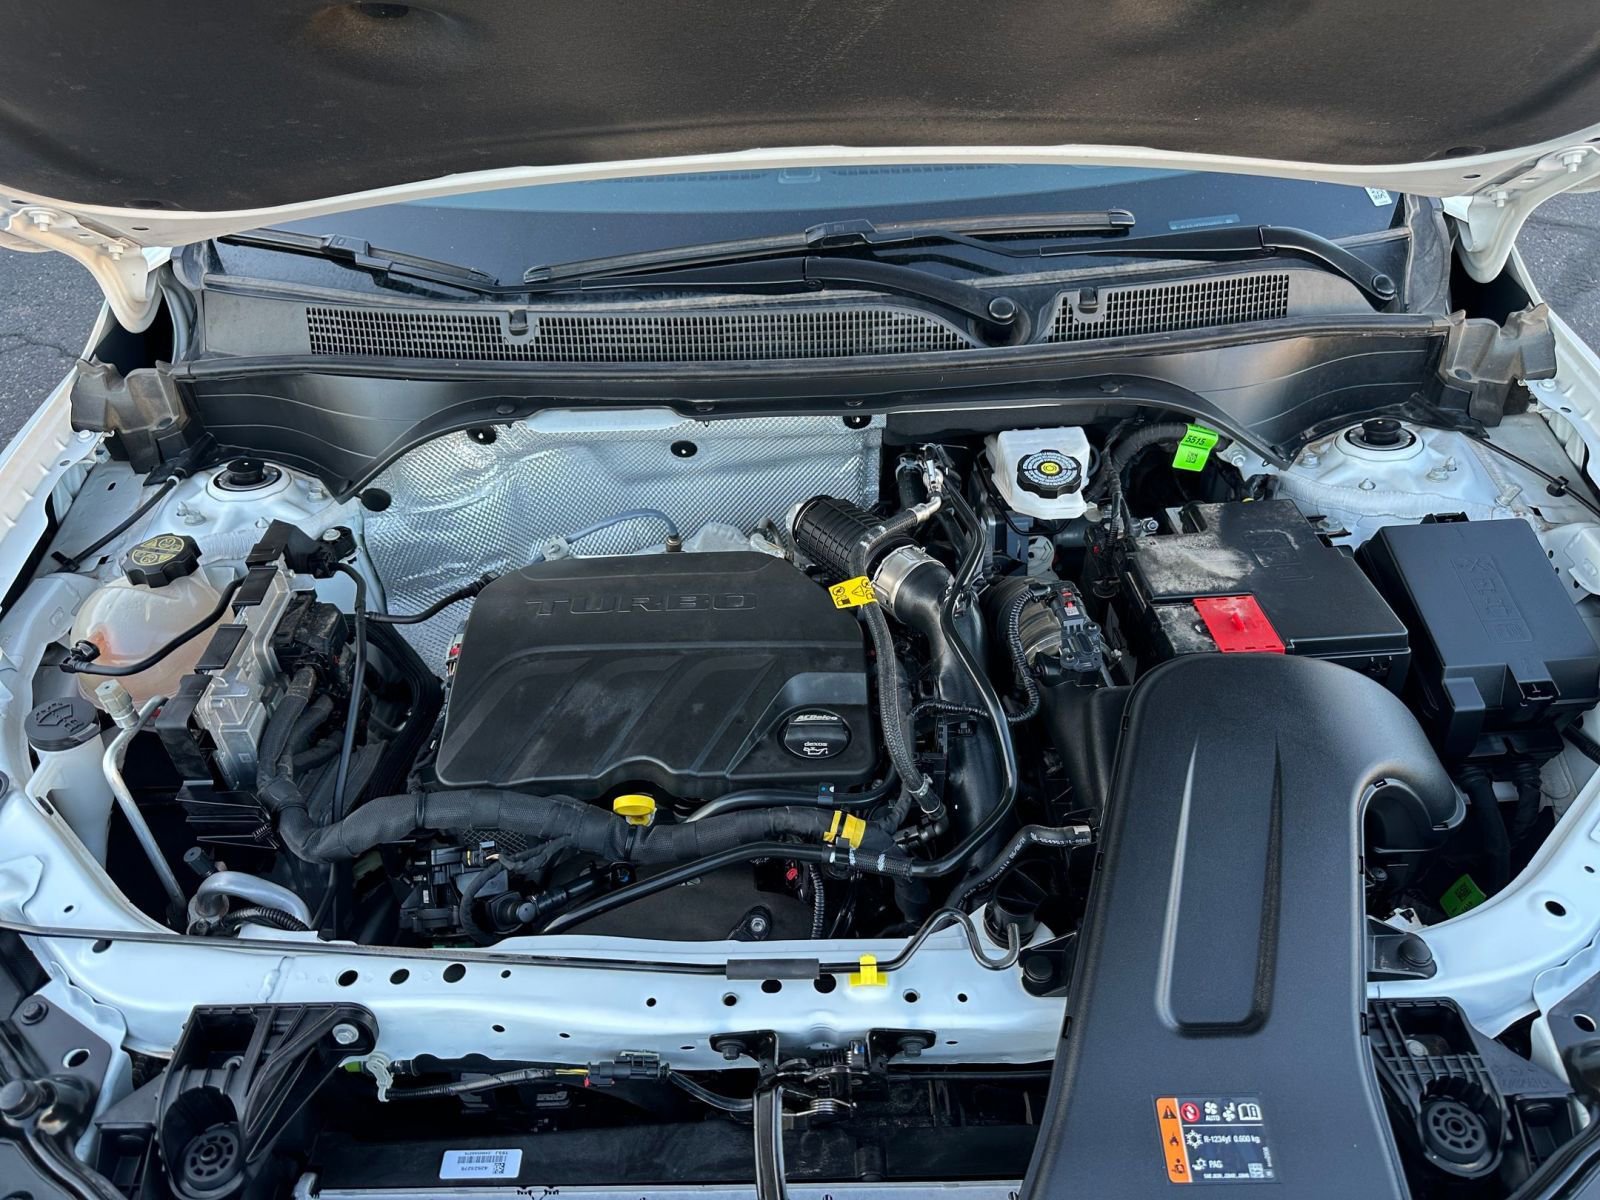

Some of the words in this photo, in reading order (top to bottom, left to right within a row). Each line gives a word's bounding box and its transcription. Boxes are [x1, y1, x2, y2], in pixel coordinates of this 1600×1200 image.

[1185, 435, 1206, 446] 5515
[525, 593, 757, 615] TURBO
[794, 714, 838, 722] ACDelco
[1251, 1135, 1260, 1144] kg
[1208, 1160, 1223, 1169] PAG
